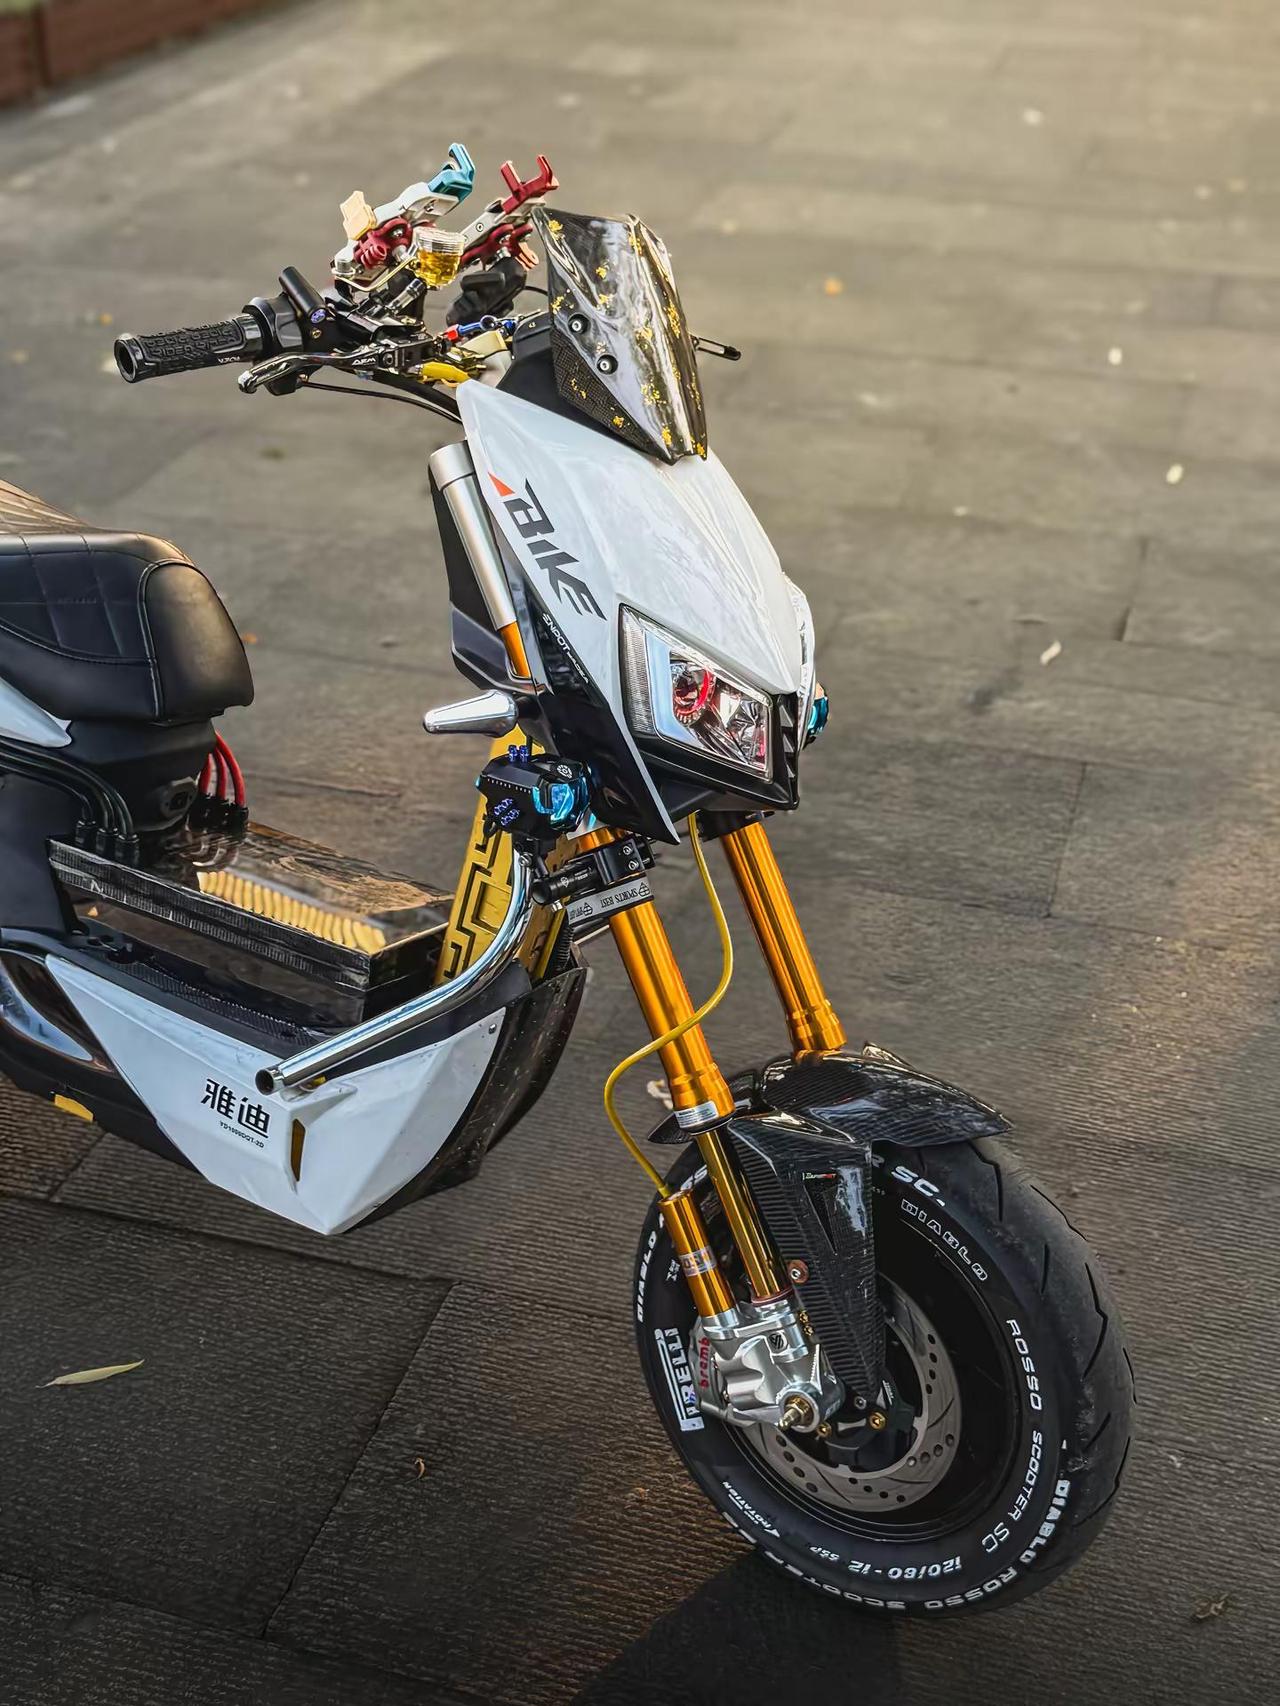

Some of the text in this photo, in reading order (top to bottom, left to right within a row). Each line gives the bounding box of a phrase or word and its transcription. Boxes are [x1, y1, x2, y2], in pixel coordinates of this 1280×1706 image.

[201, 1078, 270, 1139] 雅迪
[901, 1198, 1043, 1553] DIABLO ROSSO SCOOTER SC
[722, 1481, 772, 1529] ROTATION
[1019, 1479, 1071, 1564] DIABLO
[924, 1566, 1018, 1610] ROSSO
